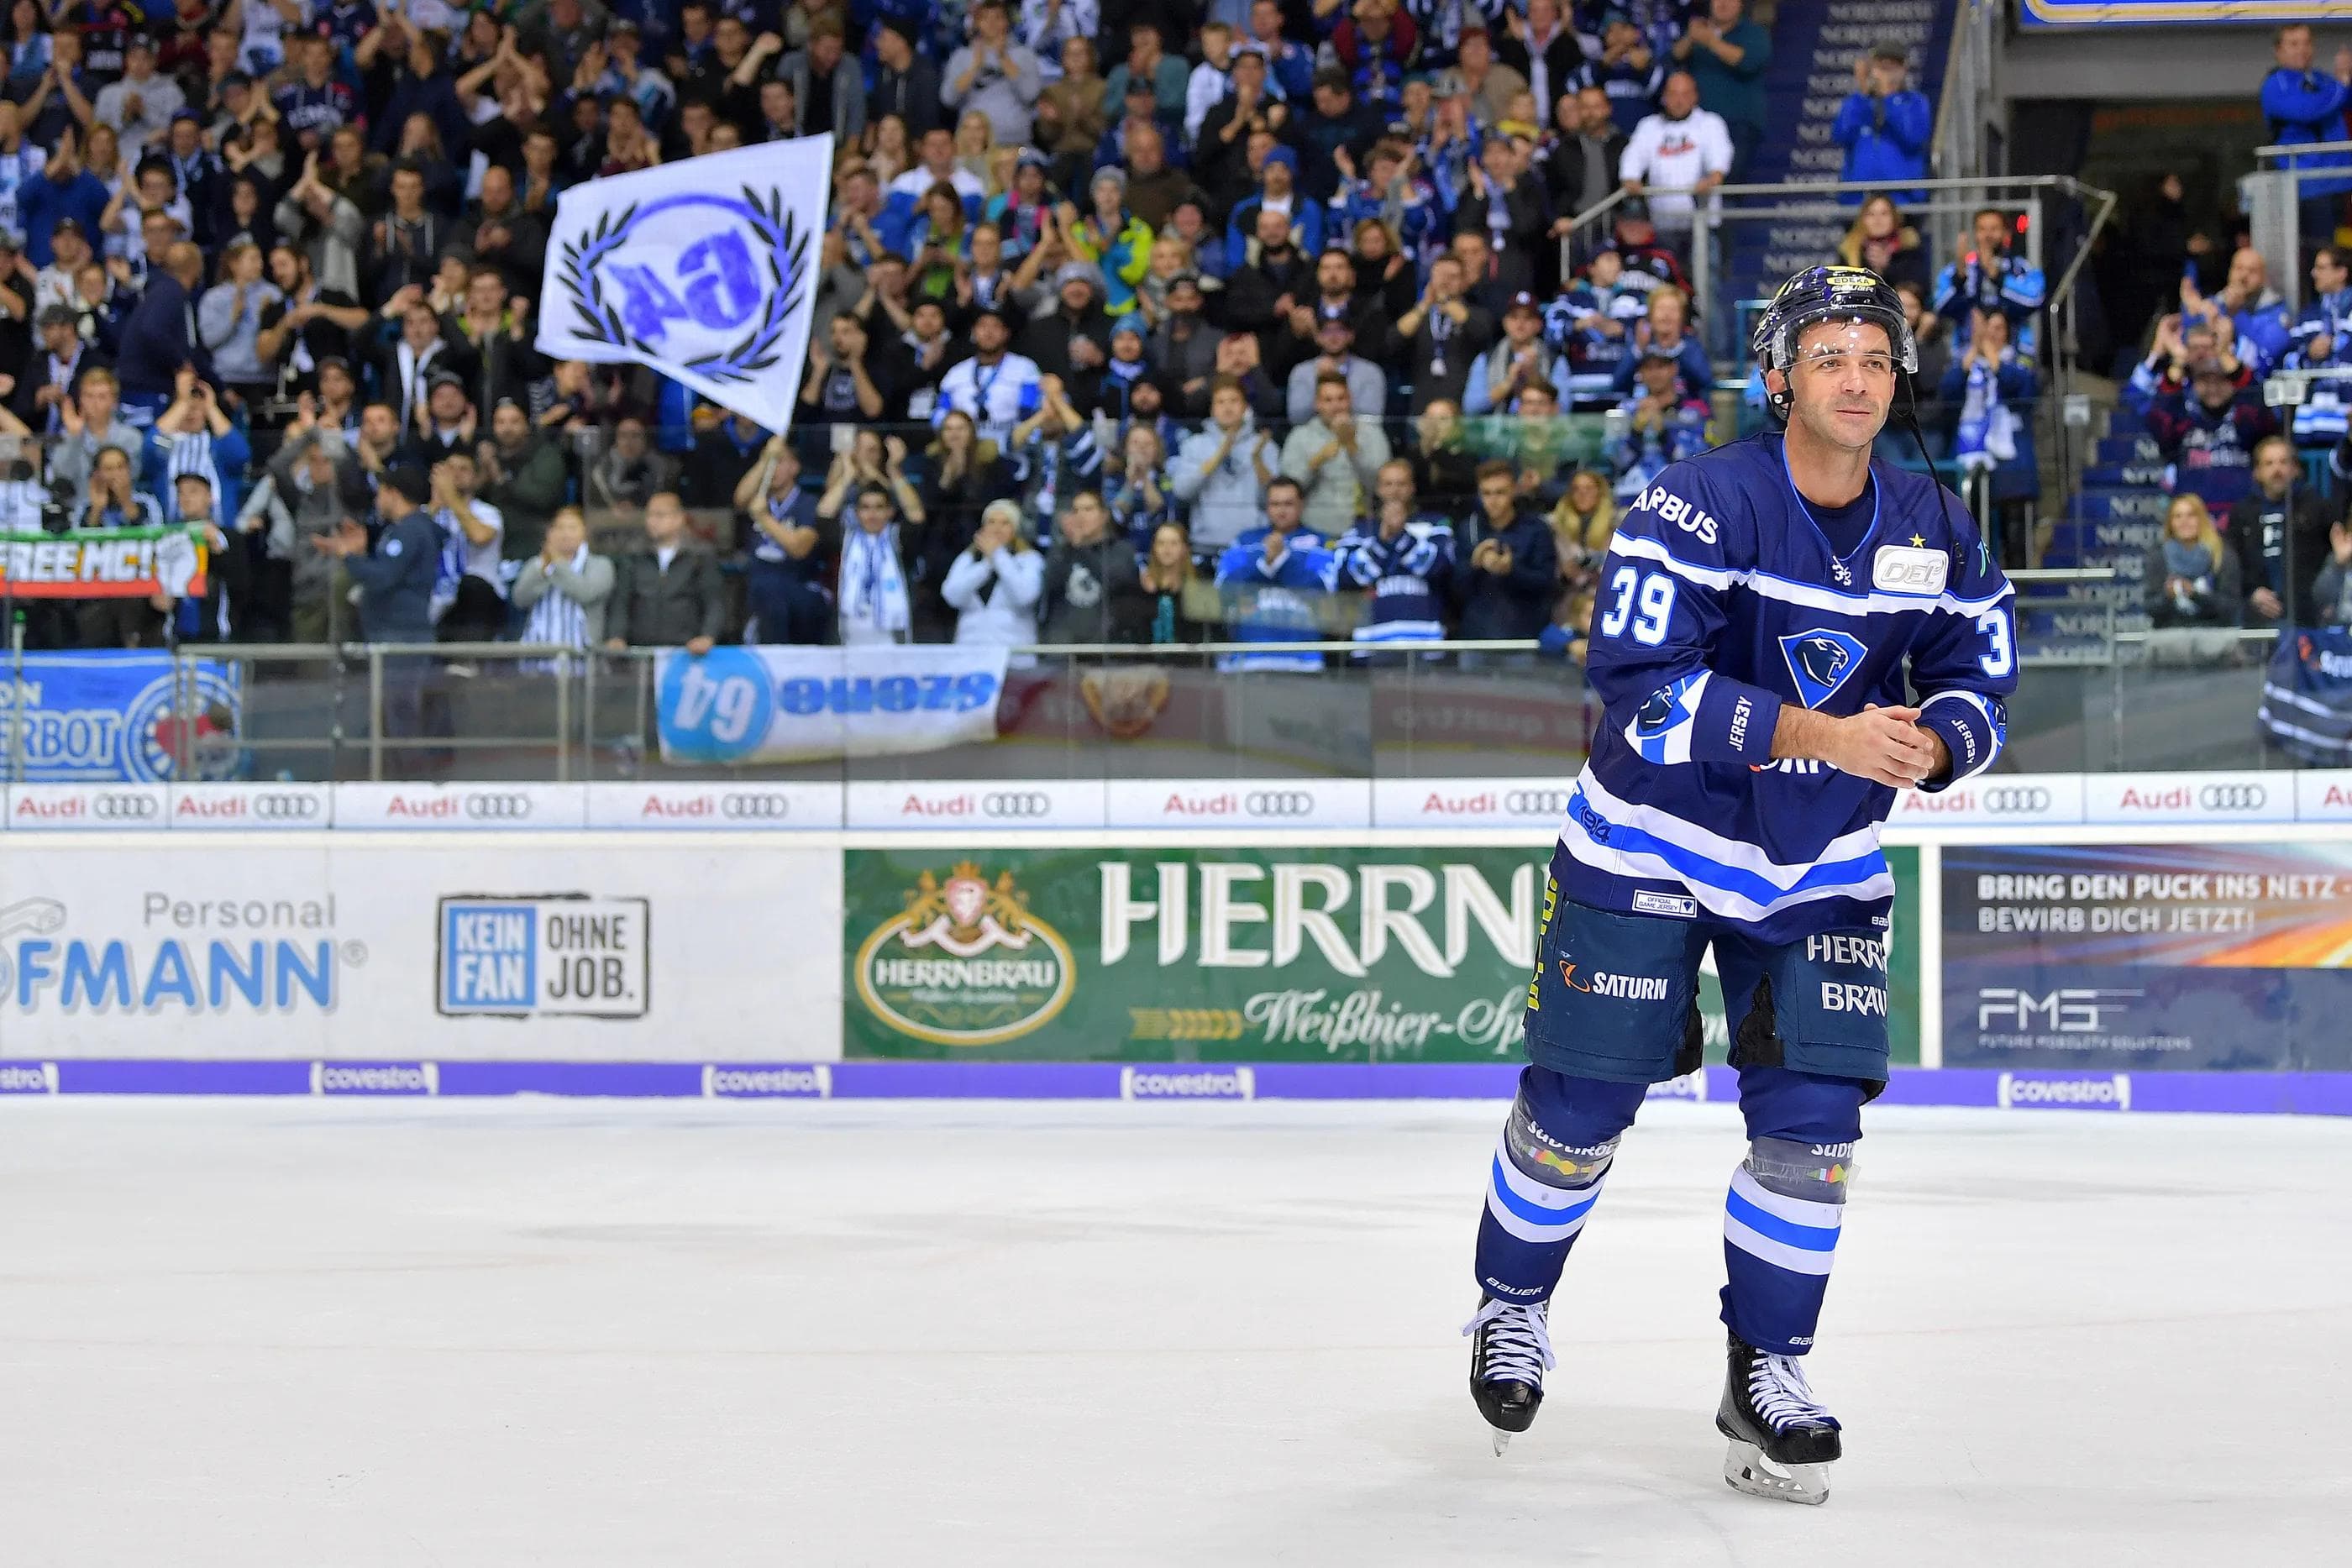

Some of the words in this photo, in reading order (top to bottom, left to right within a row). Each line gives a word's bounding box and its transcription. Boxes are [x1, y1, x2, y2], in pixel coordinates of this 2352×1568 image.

[1630, 486, 1719, 544] ARBUS
[1601, 566, 1677, 647] 39
[1976, 606, 2019, 679] 3
[675, 664, 755, 743] 64
[17, 796, 86, 818] Audi
[176, 795, 247, 818] Audi
[386, 794, 459, 817] Audi
[642, 794, 714, 817] Audi
[901, 794, 975, 815] Audi
[1163, 793, 1238, 815] Audi
[1423, 792, 1496, 814] Audi
[1903, 789, 1976, 812] Audi
[2120, 788, 2192, 809] Audi
[1647, 896, 1672, 905] OFFICIAL
[1977, 874, 2064, 900] BRING
[2070, 874, 2128, 900] DEN
[2134, 874, 2210, 900] PUCK
[2216, 874, 2261, 899] INS
[2267, 874, 2336, 899] NETZ
[144, 891, 336, 929] Personal
[1098, 862, 1548, 978] HERRN
[1639, 901, 1656, 910] GAME
[1656, 903, 1678, 911] JERSEY
[1977, 906, 2086, 933] BEWIRB
[2091, 906, 2161, 933] DICH
[2166, 905, 2255, 932] JETZT!
[456, 913, 528, 951] KEIN
[547, 915, 627, 951] OHNE
[0, 937, 334, 1012] FMANN
[456, 953, 528, 1001] FAN
[548, 956, 634, 1000] JOB.
[1592, 972, 1669, 1000] SATURN
[1979, 988, 2100, 1032] FMS
